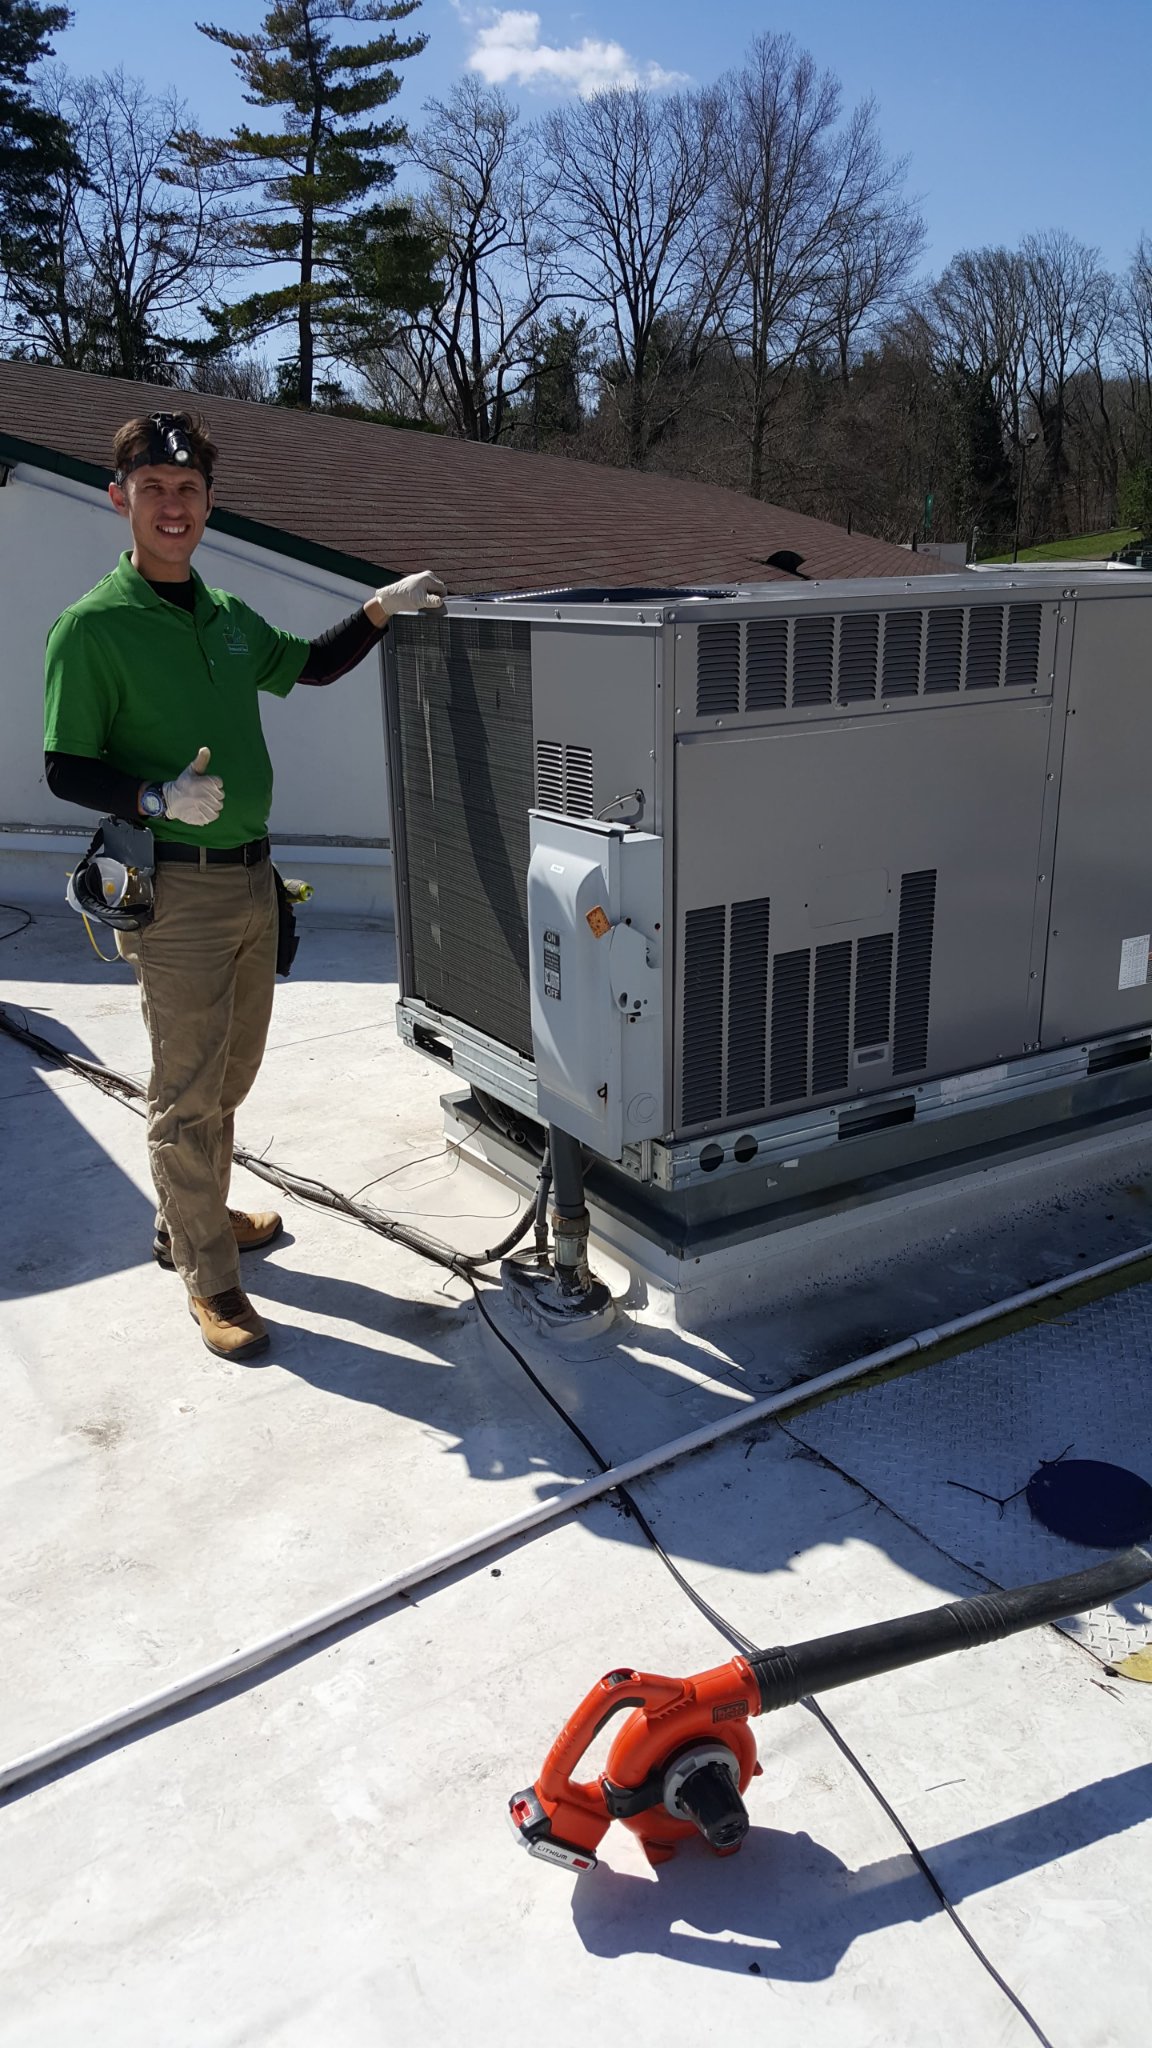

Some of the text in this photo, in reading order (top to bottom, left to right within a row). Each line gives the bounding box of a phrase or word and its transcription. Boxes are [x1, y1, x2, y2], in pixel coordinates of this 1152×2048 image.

[546, 932, 556, 944] ON
[546, 987, 559, 999] OFF
[537, 1845, 568, 1860] LITHIUM
